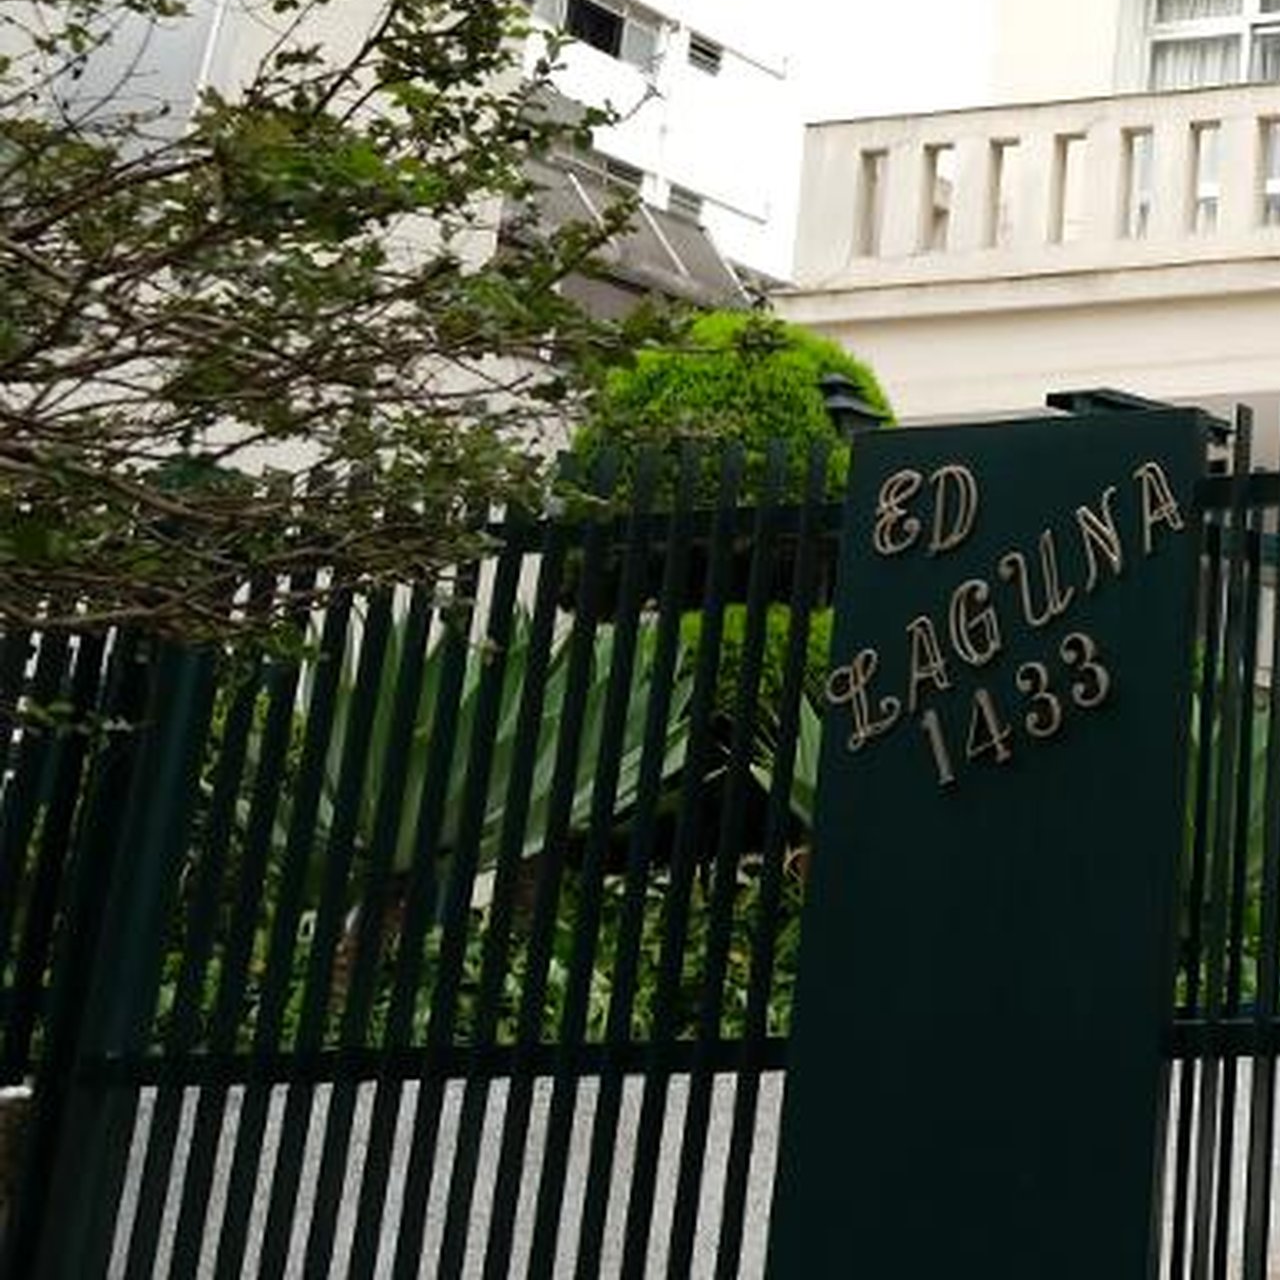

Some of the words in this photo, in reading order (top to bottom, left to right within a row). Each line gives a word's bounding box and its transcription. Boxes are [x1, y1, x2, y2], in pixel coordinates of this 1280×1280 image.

[873, 465, 979, 556] ED
[825, 461, 1185, 751] LAGUNA
[922, 632, 1110, 785] 1433
